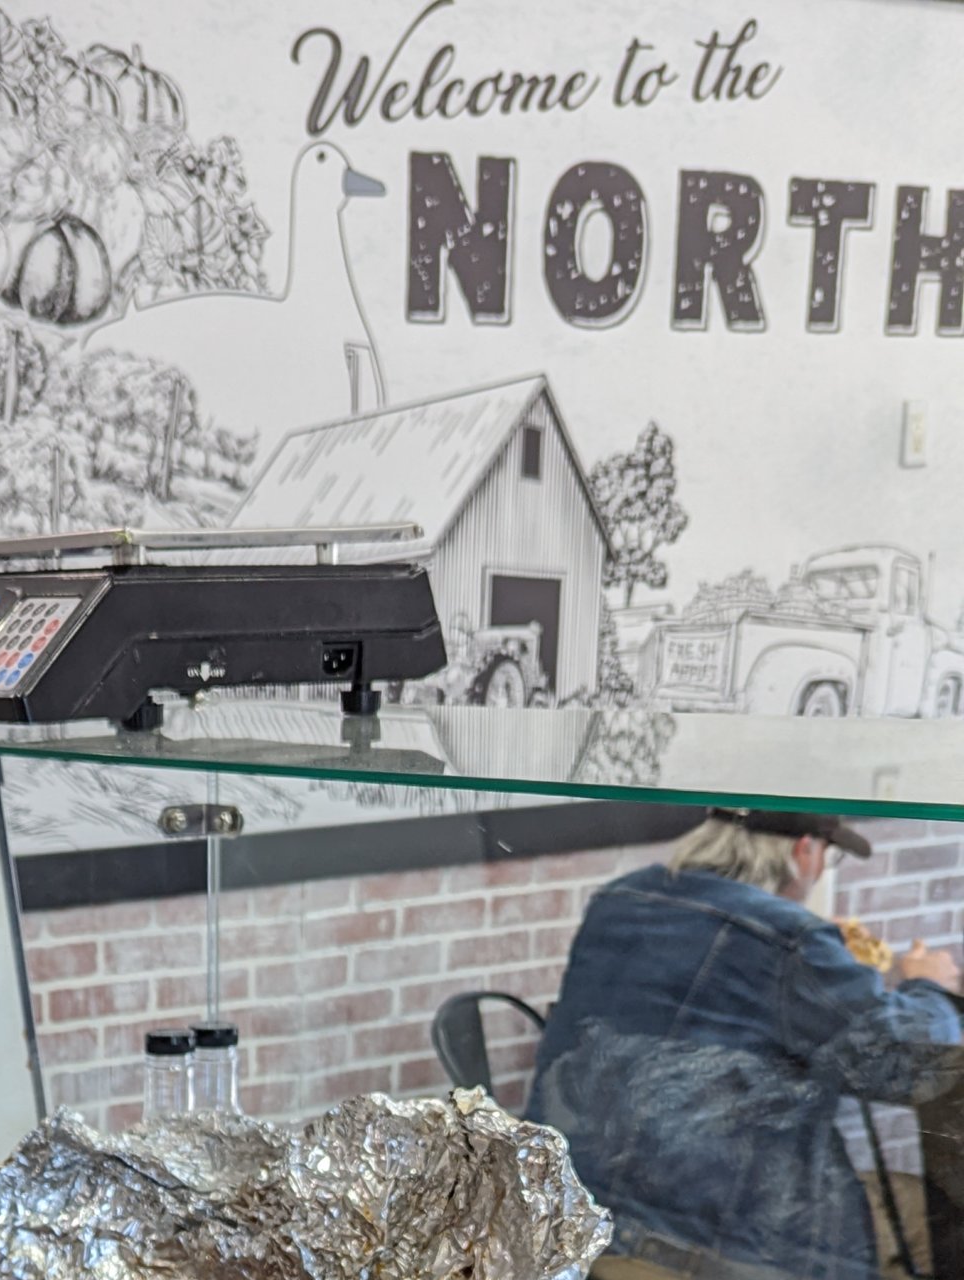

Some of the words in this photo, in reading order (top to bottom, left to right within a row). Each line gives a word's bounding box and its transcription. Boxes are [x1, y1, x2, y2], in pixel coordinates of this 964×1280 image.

[290, 0, 600, 137] Welcome
[612, 36, 679, 108] to
[691, 18, 784, 103] the
[405, 150, 964, 337] NORTH
